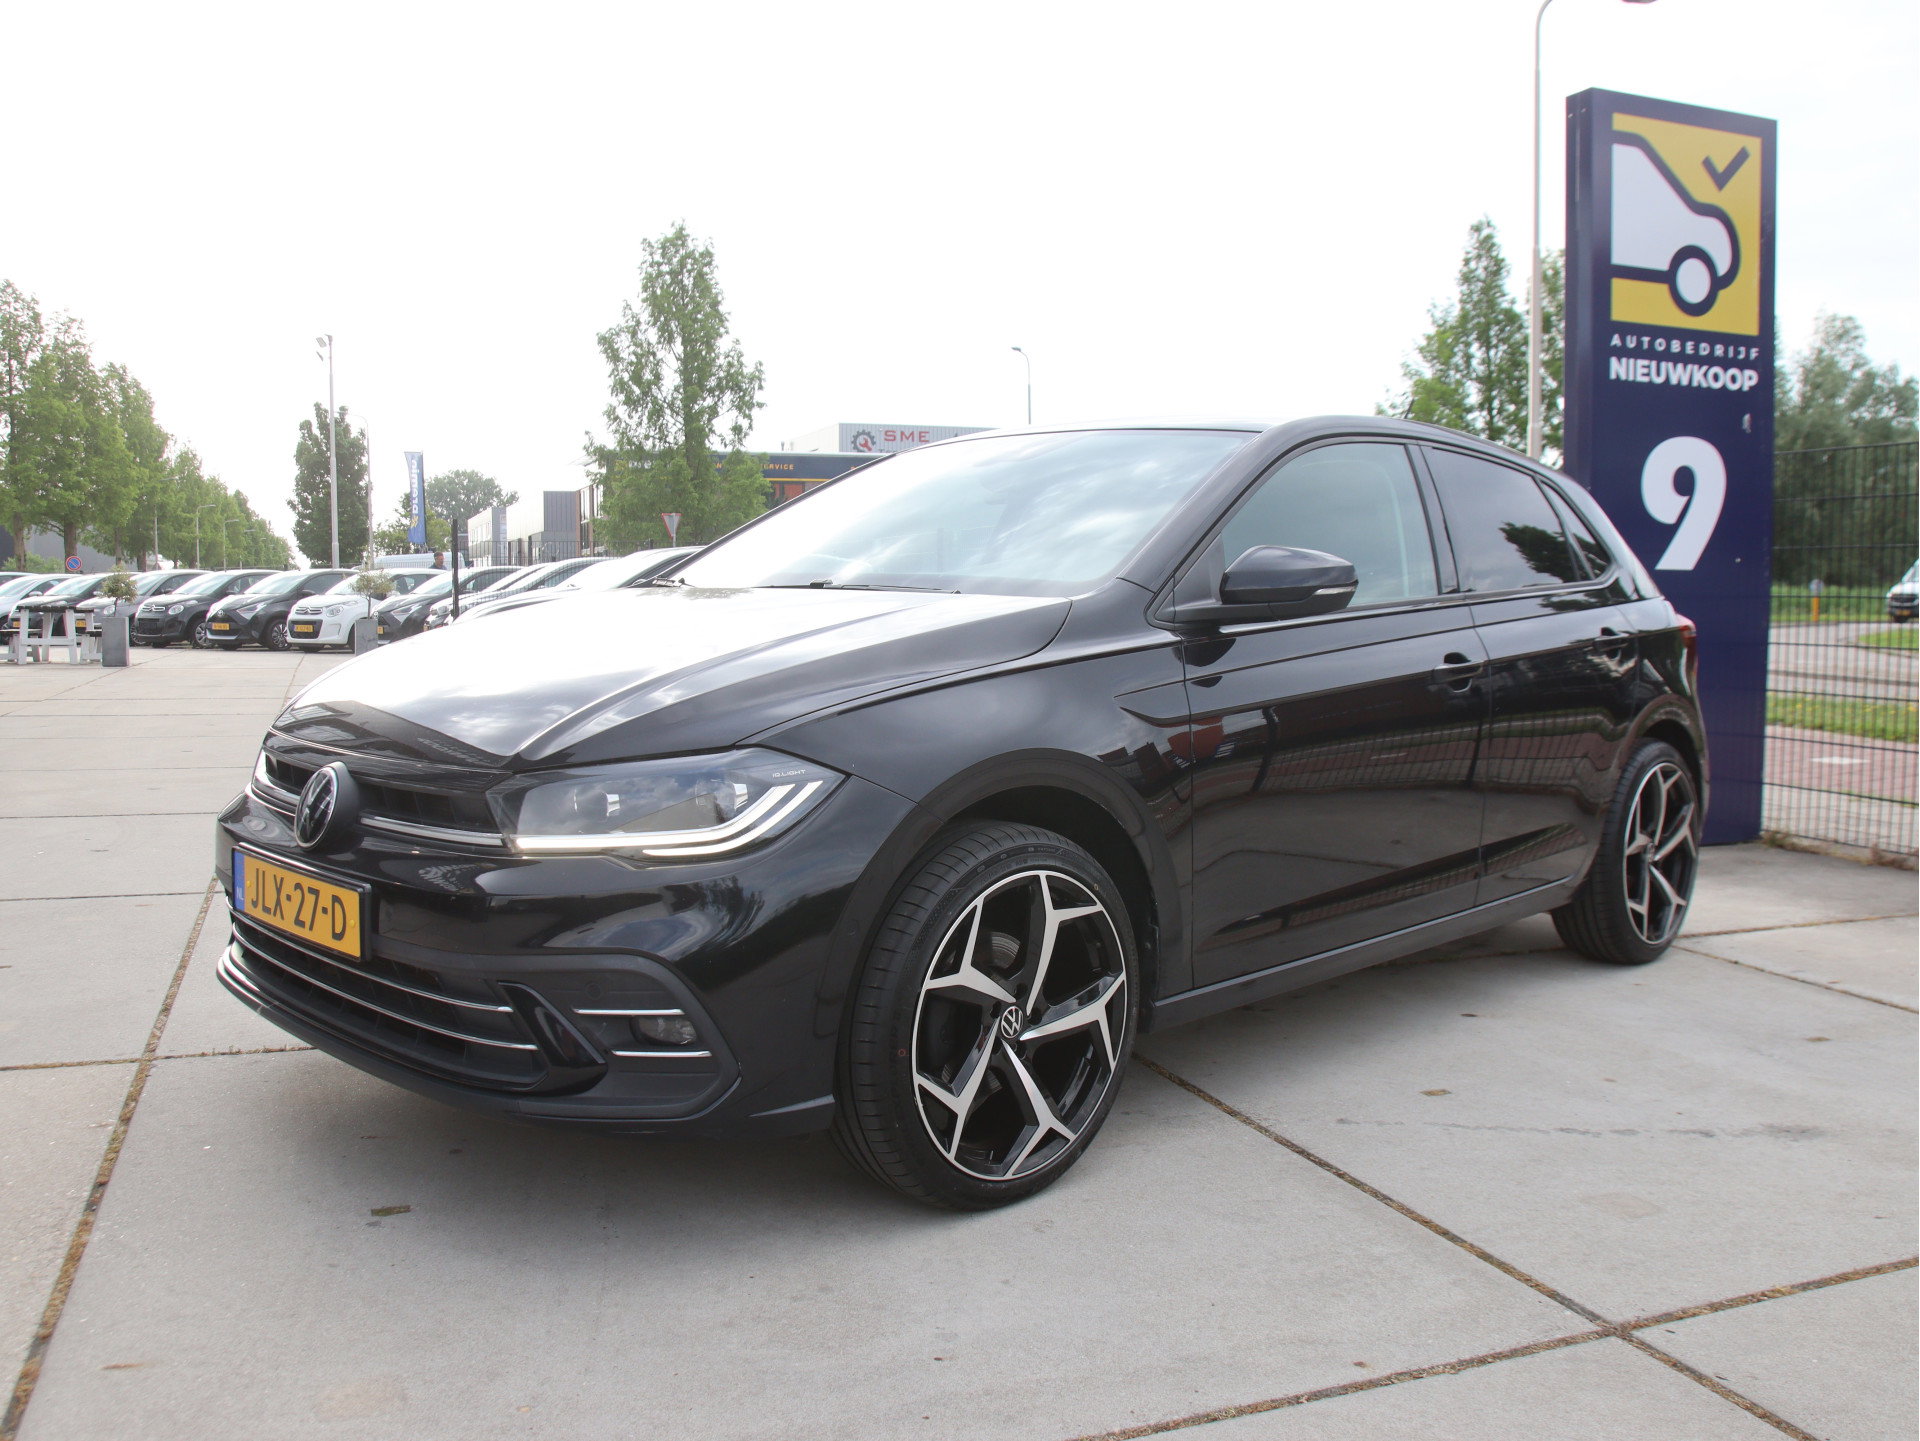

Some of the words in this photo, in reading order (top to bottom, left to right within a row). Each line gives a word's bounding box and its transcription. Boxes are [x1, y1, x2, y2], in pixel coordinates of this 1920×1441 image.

[1610, 333, 1760, 361] AUTOBEDRIJF
[1609, 356, 1759, 392] NIEUWKOOP
[884, 430, 930, 443] SME
[1640, 435, 1727, 571] 9
[236, 886, 244, 901] NL
[251, 867, 347, 941] JLX-27-D
